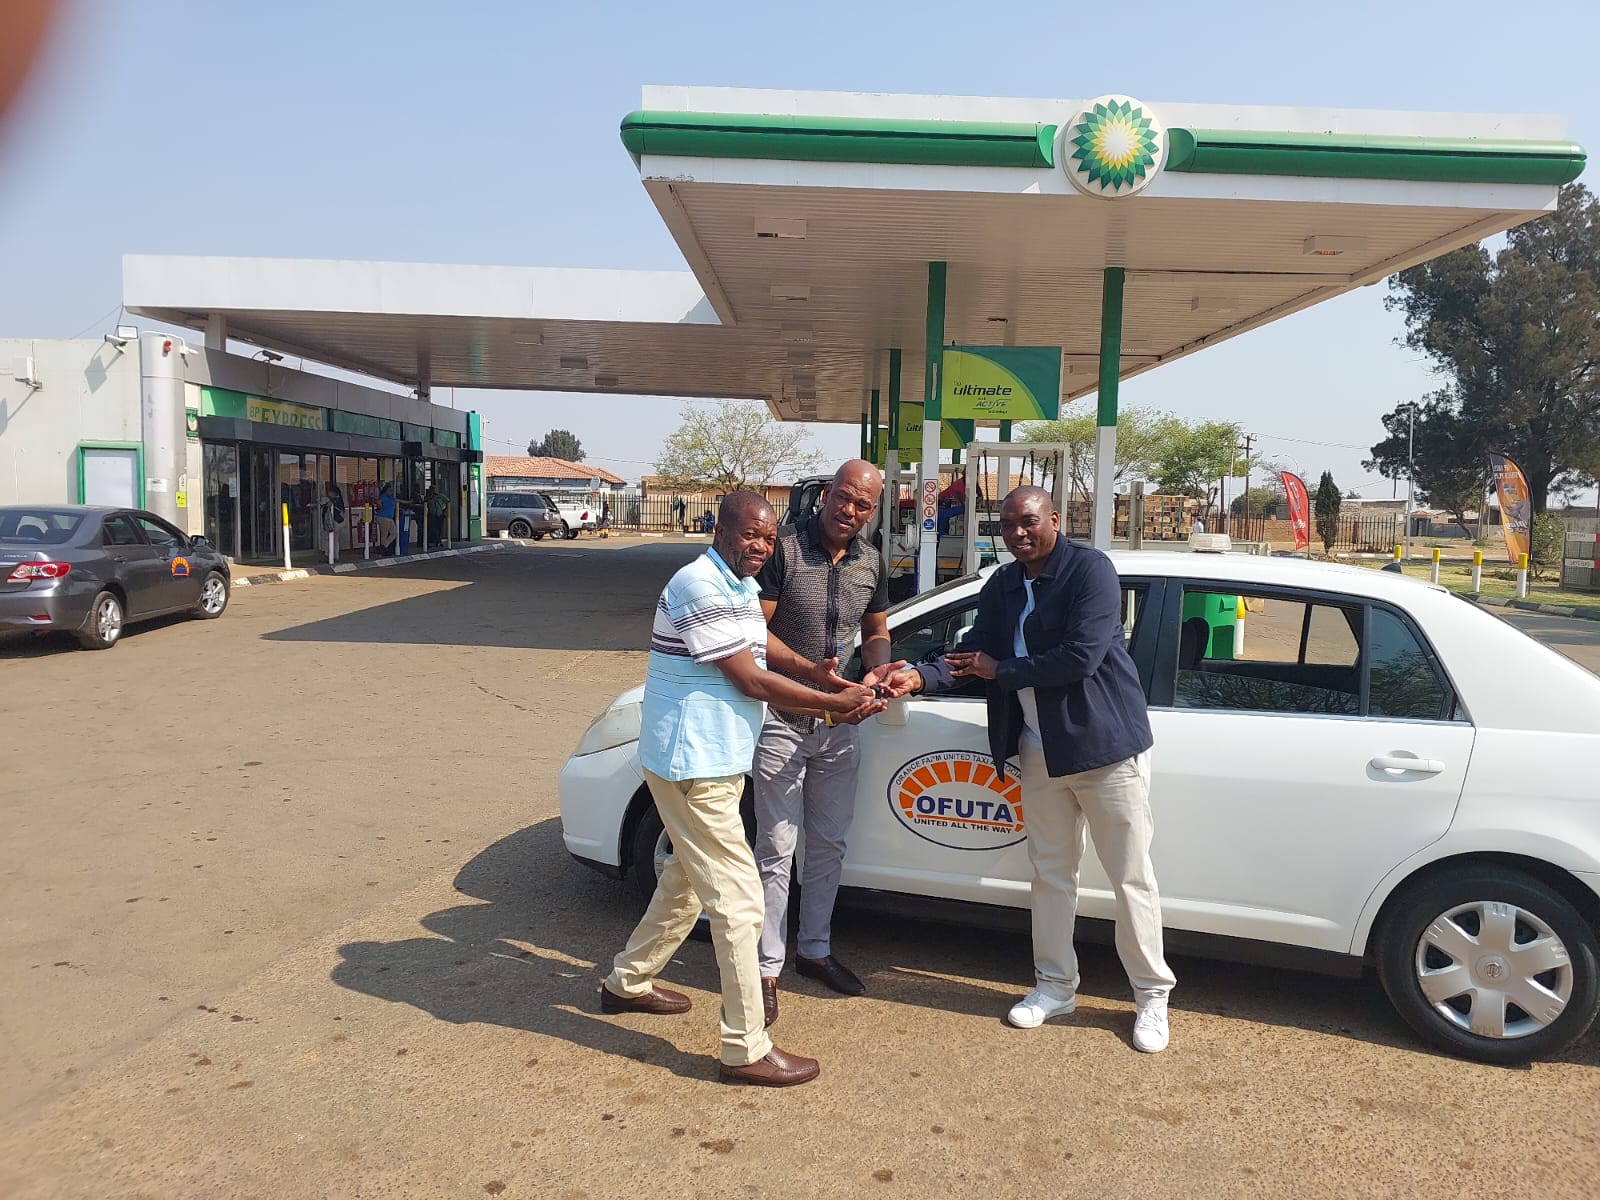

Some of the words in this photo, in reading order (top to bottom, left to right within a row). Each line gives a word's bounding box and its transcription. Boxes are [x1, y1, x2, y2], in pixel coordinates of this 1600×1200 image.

[953, 384, 1012, 396] ultimate
[249, 406, 260, 418] BP
[943, 753, 970, 761] UNITED
[973, 755, 989, 764] TAXI
[916, 795, 1013, 823] OFUTA
[914, 818, 948, 828] UNITED
[950, 821, 968, 830] ALL
[970, 823, 989, 832] THE
[992, 825, 1013, 835] WAY
